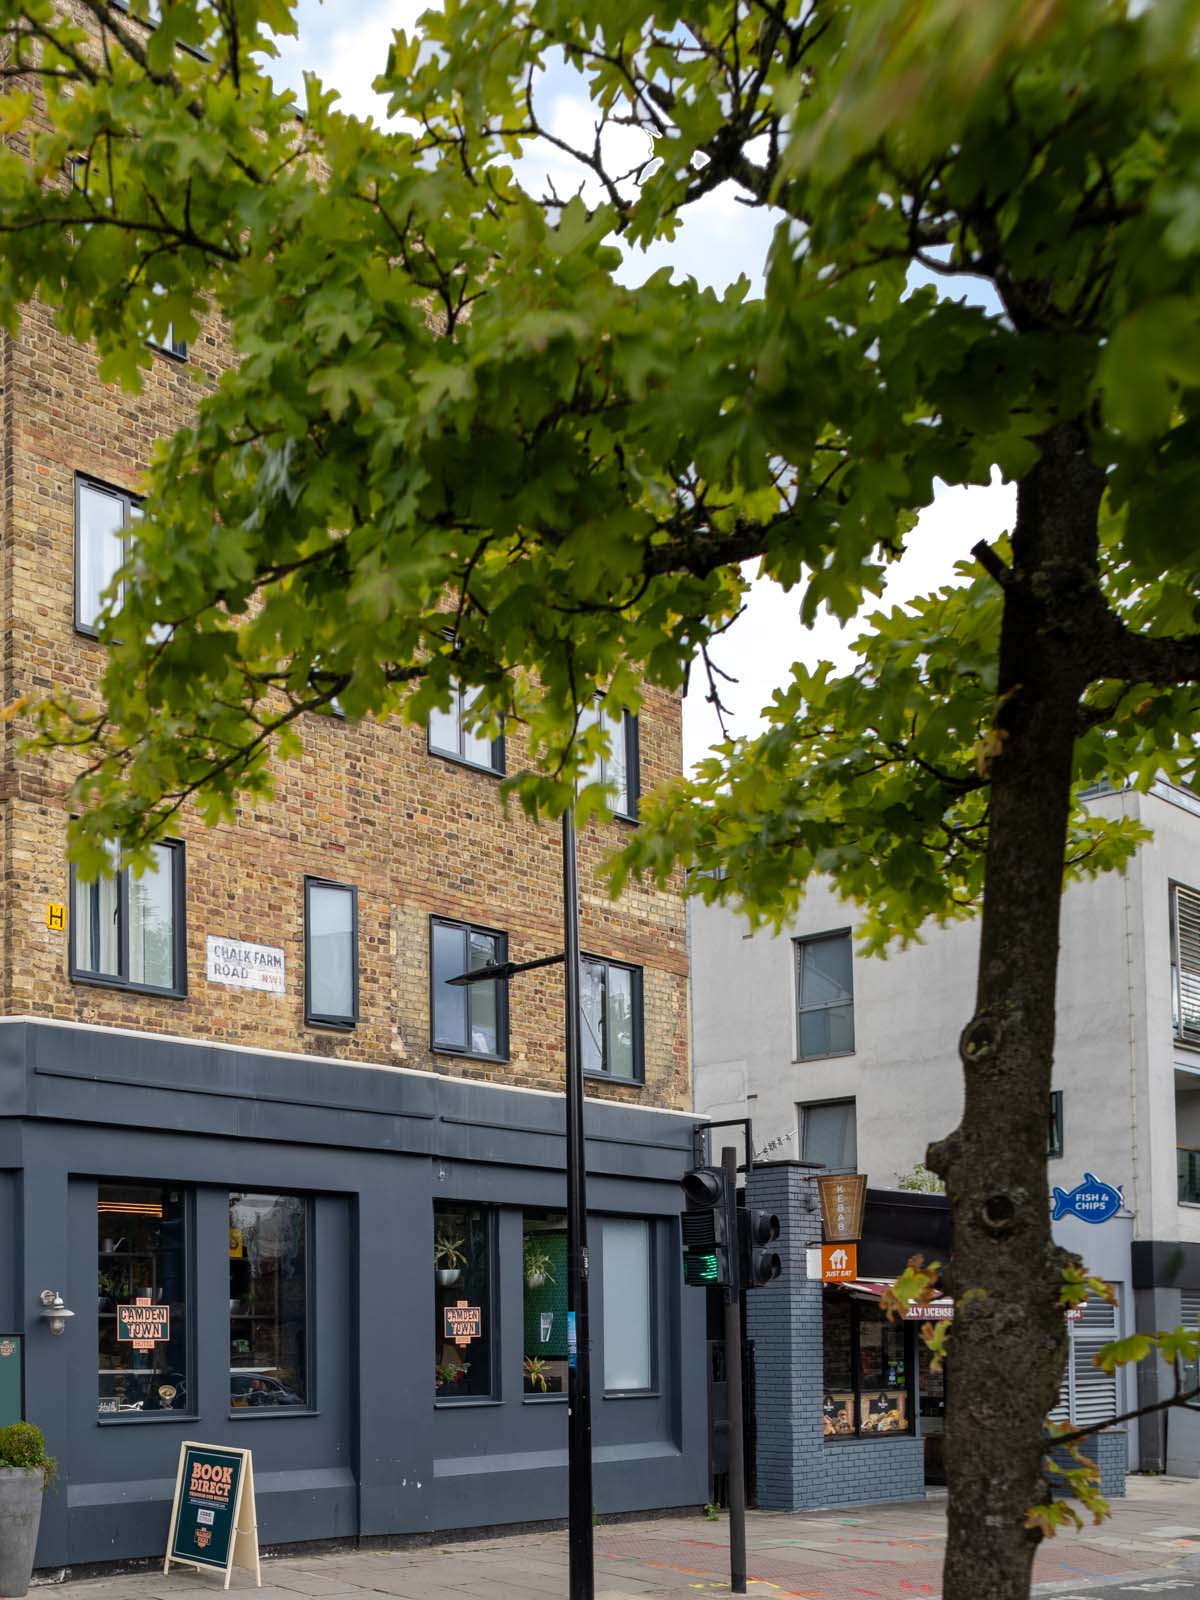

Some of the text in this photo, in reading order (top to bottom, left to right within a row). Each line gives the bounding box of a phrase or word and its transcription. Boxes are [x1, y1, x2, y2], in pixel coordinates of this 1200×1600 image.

[50, 904, 63, 928] H
[214, 944, 251, 963] CHALK
[254, 951, 282, 969] FARM
[214, 963, 249, 979] ROAD
[1075, 1193, 1109, 1202] FISH &
[835, 1184, 846, 1232] KEBAB
[1075, 1202, 1106, 1211] CHIPS
[825, 1270, 840, 1278] JUST
[120, 1306, 168, 1324] CAMDEN
[447, 1309, 480, 1323] CAMDEN
[924, 1307, 954, 1317] LICENSE
[127, 1322, 162, 1338] TOWN
[451, 1322, 477, 1336] TOWN
[192, 1462, 233, 1484] BOOK
[190, 1478, 231, 1496] DIRECT
